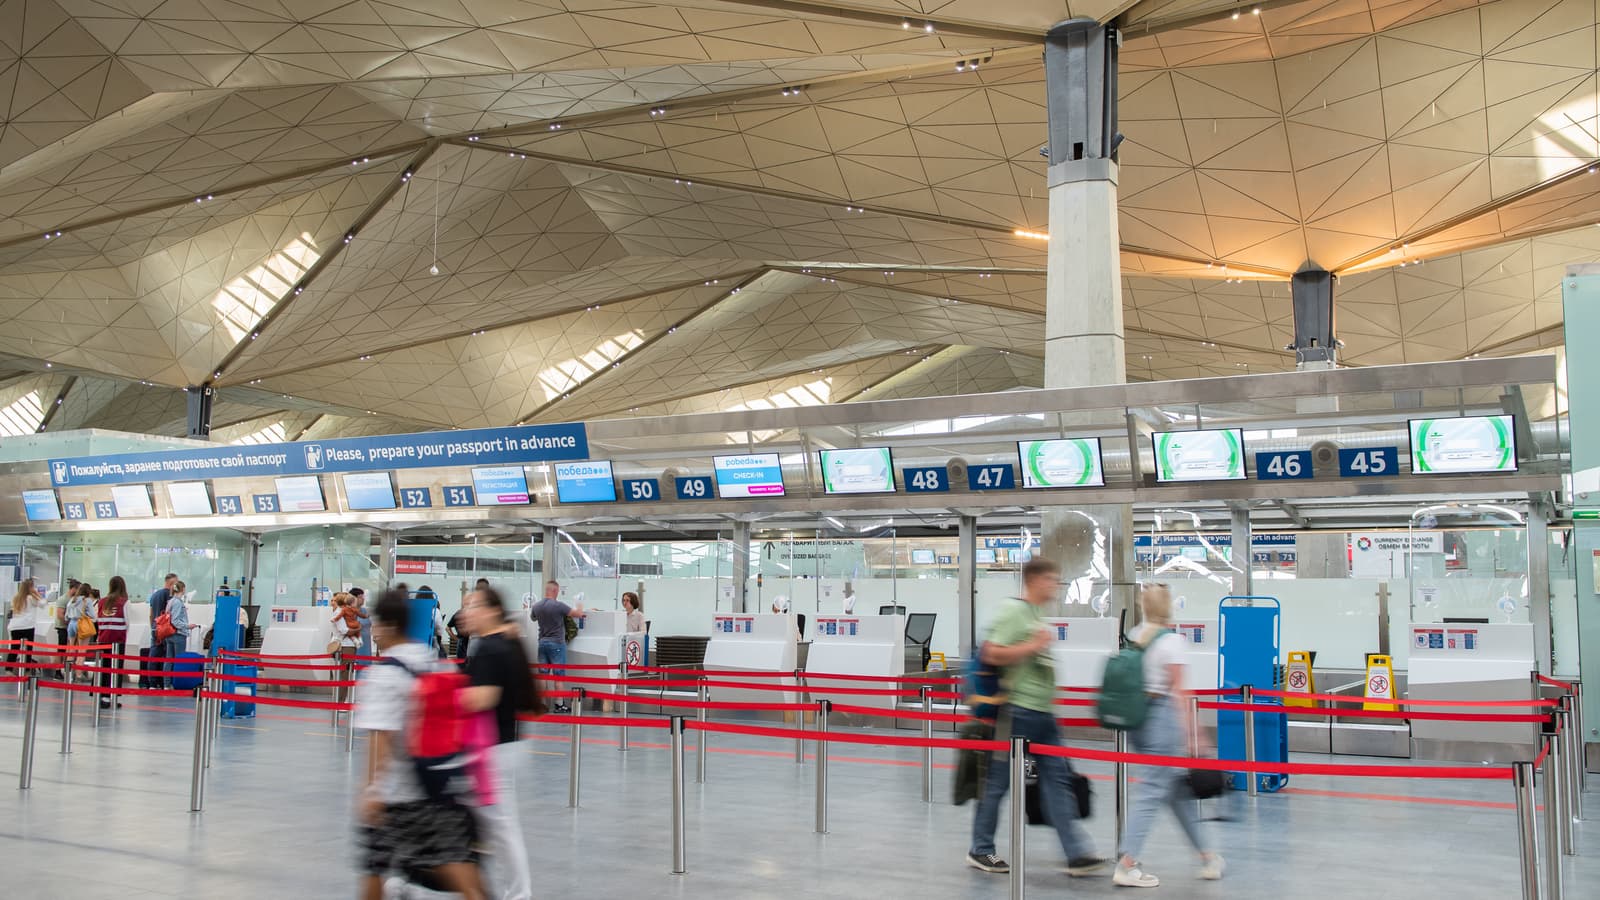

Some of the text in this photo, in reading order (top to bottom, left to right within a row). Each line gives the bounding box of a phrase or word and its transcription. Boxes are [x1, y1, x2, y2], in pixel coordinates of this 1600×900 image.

[326, 435, 576, 462] Please, prepare your passport in advance
[71, 454, 286, 477] Пожалуйста, заранее подготовьте свой паспорт
[726, 458, 754, 467] pobeda
[1266, 454, 1301, 476] 46
[1350, 450, 1386, 474] 45
[558, 465, 593, 476] победа
[733, 472, 764, 480] CHECK-IN
[977, 468, 1004, 487] 47
[912, 470, 939, 489] 48
[631, 481, 653, 498] 50
[683, 480, 705, 496] 49
[258, 496, 274, 511] 53
[407, 490, 425, 506] 52
[450, 488, 469, 505] 51
[68, 505, 82, 518] 56
[98, 504, 112, 517] 55
[221, 498, 236, 512] 54
